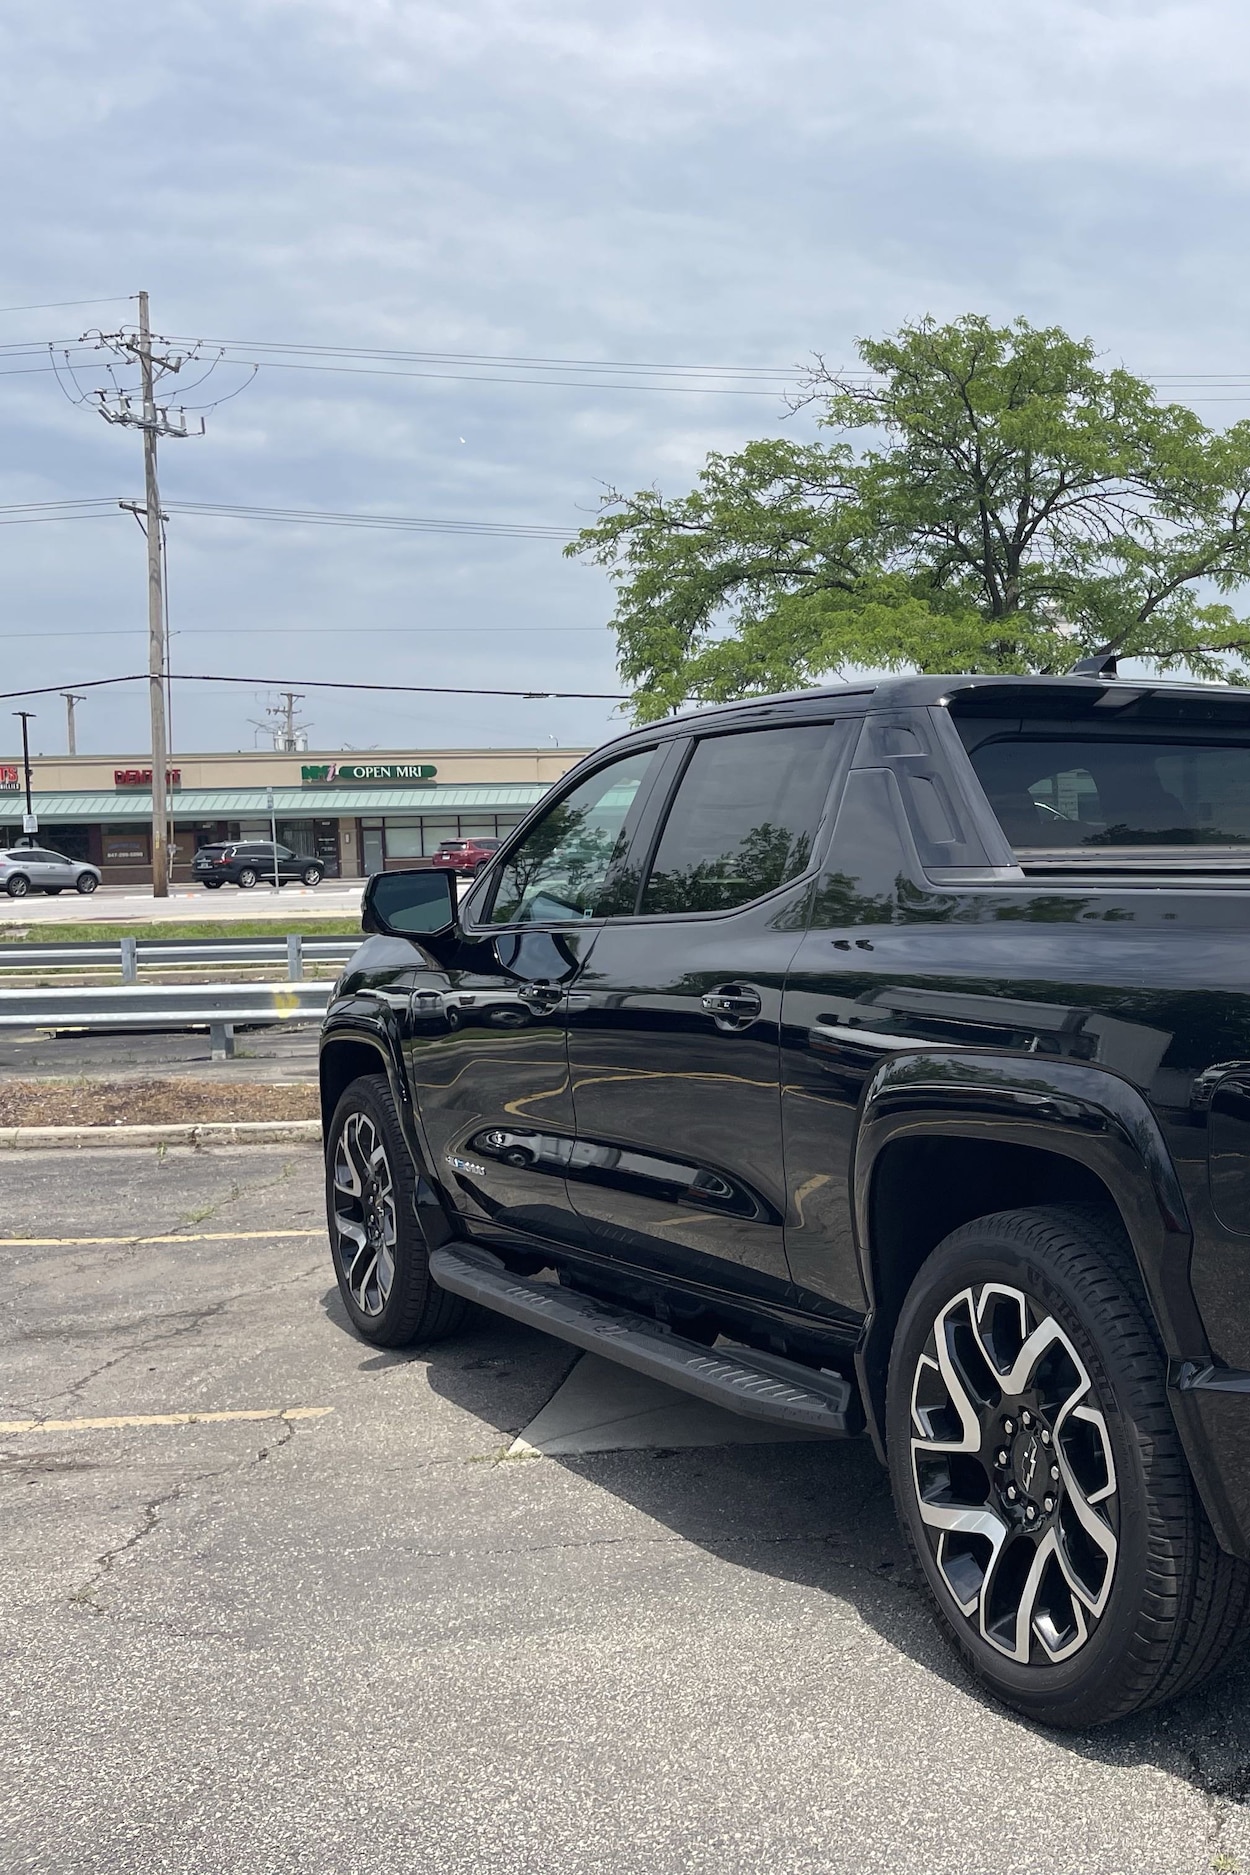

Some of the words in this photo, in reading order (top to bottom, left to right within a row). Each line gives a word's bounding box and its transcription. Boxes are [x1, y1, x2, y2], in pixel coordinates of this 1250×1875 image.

[114, 770, 182, 785] DENT
[353, 766, 391, 778] OPEN
[396, 766, 422, 778] MRI
